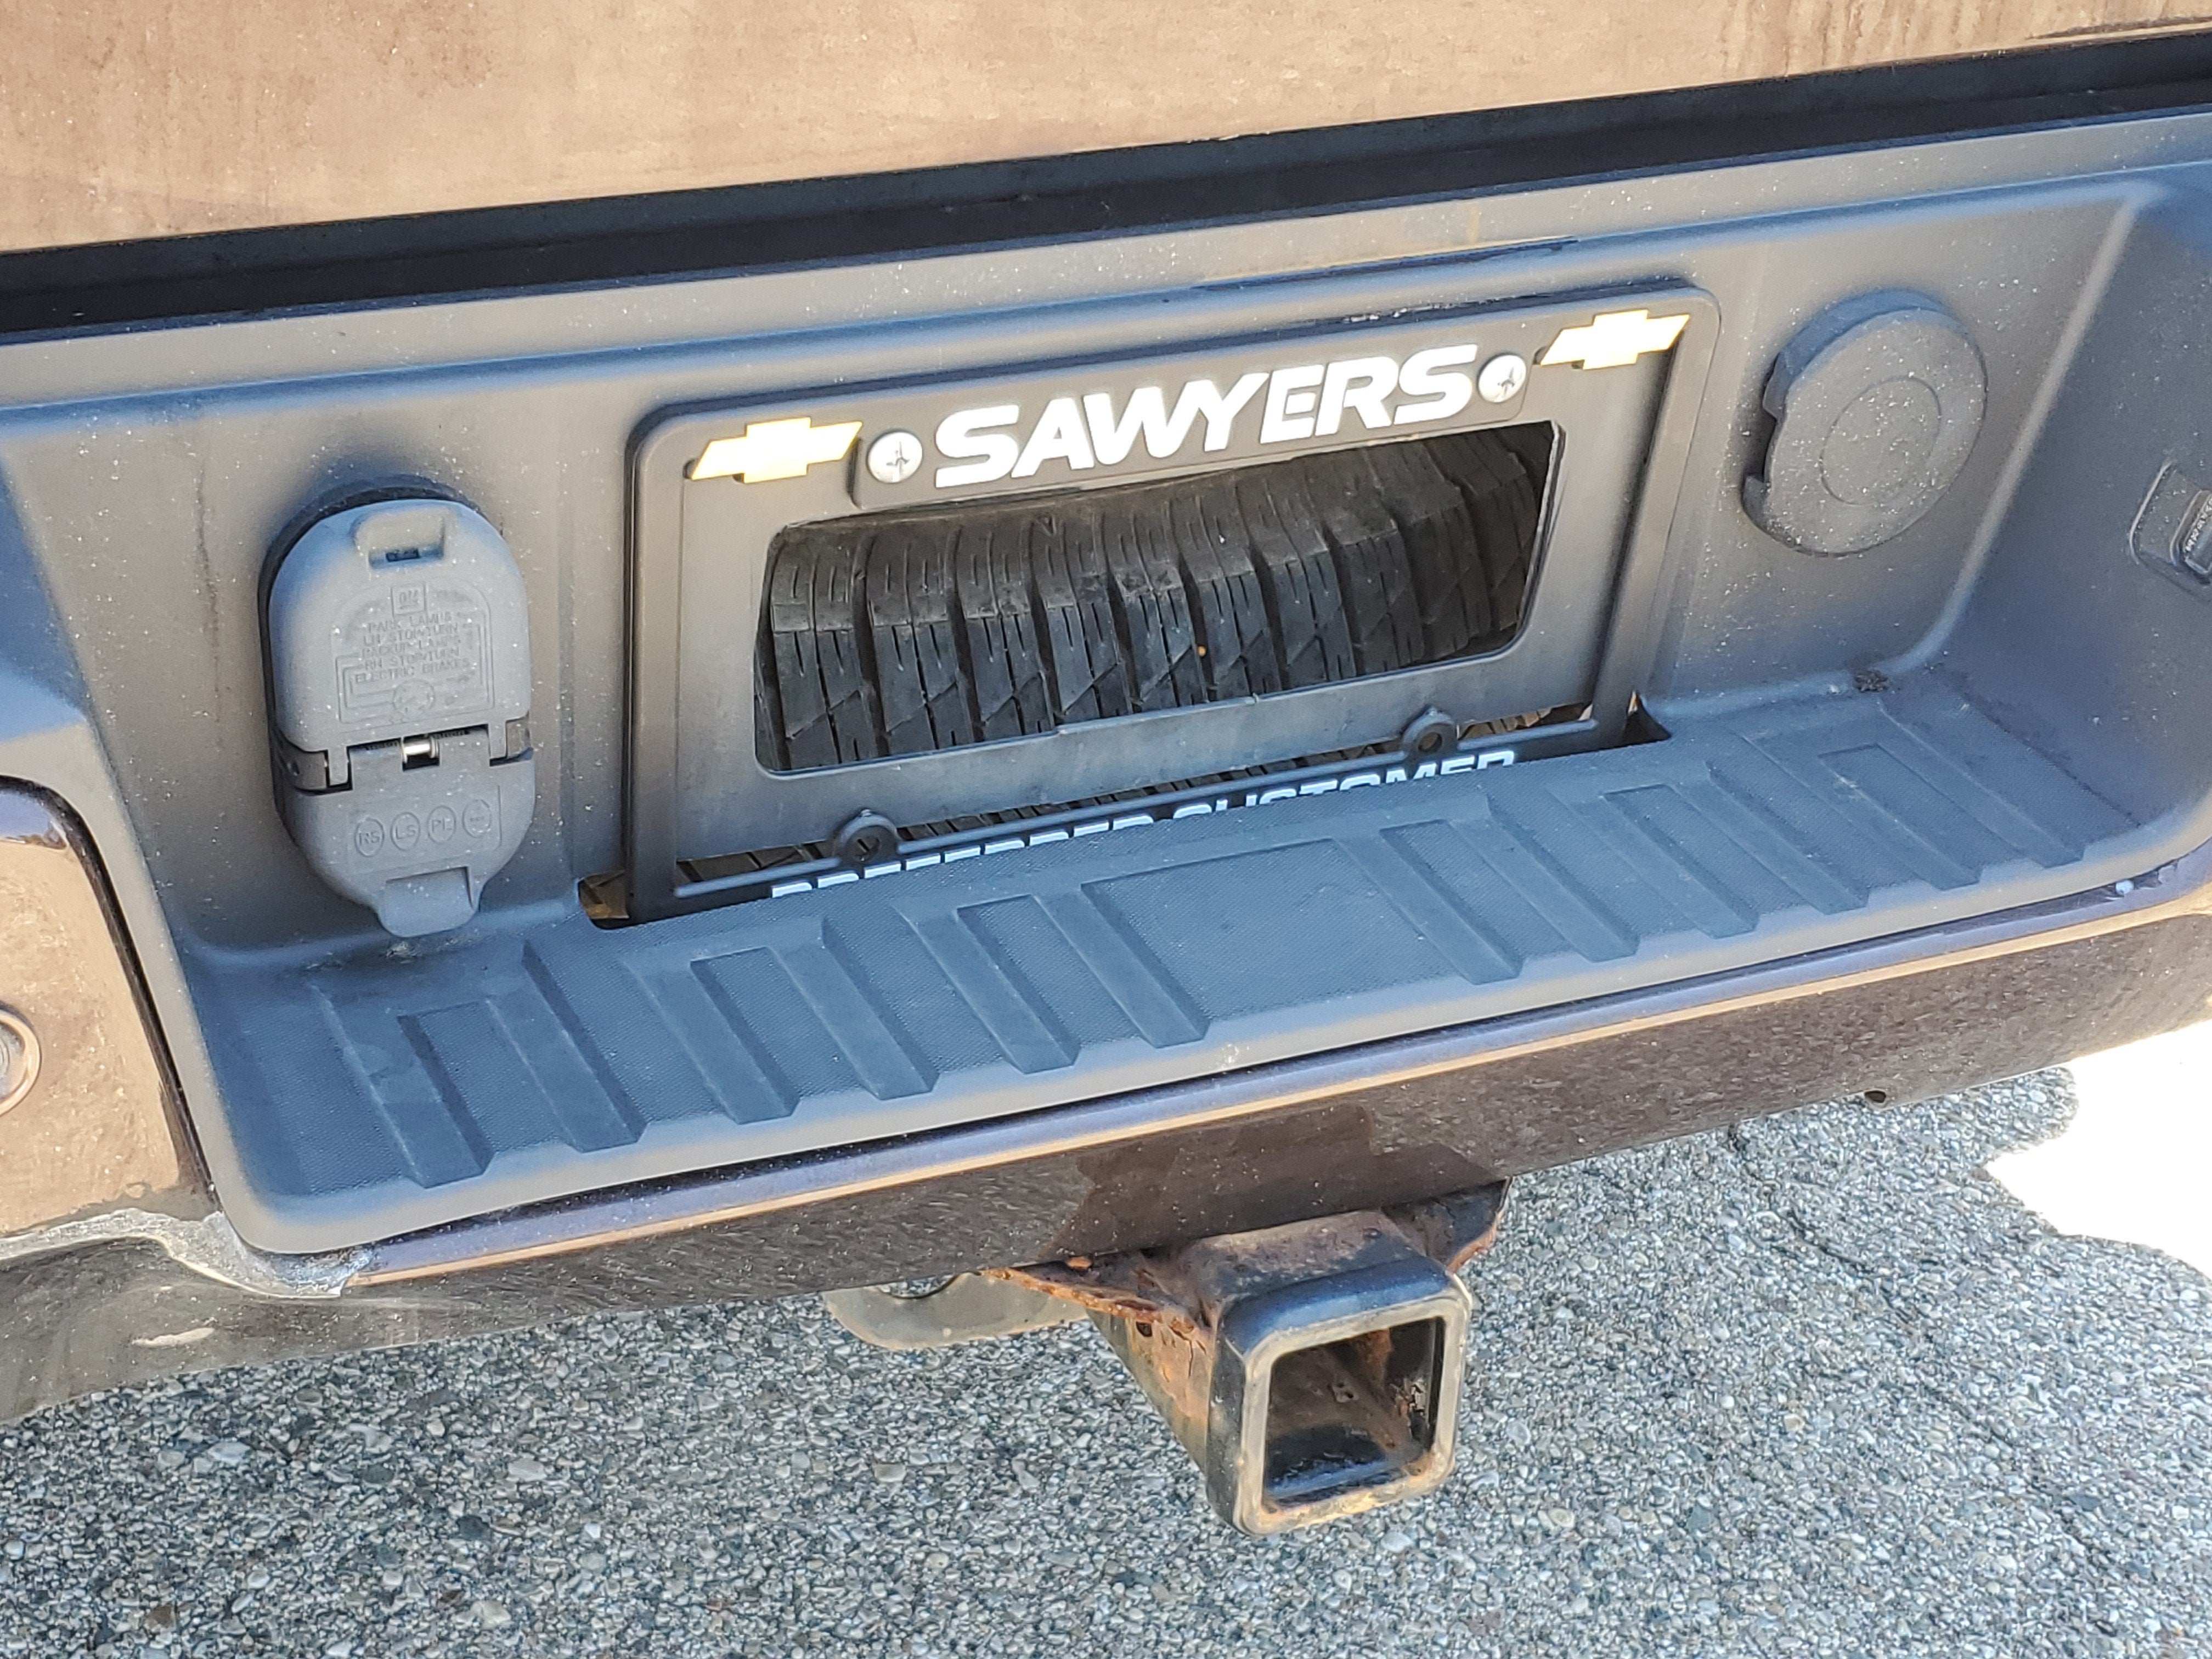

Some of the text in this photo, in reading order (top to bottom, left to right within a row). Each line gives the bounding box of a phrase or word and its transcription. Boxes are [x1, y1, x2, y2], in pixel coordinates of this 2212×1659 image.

[935, 343, 1479, 488] SAWYERS
[359, 830, 380, 845] RS
[396, 824, 417, 840] LS
